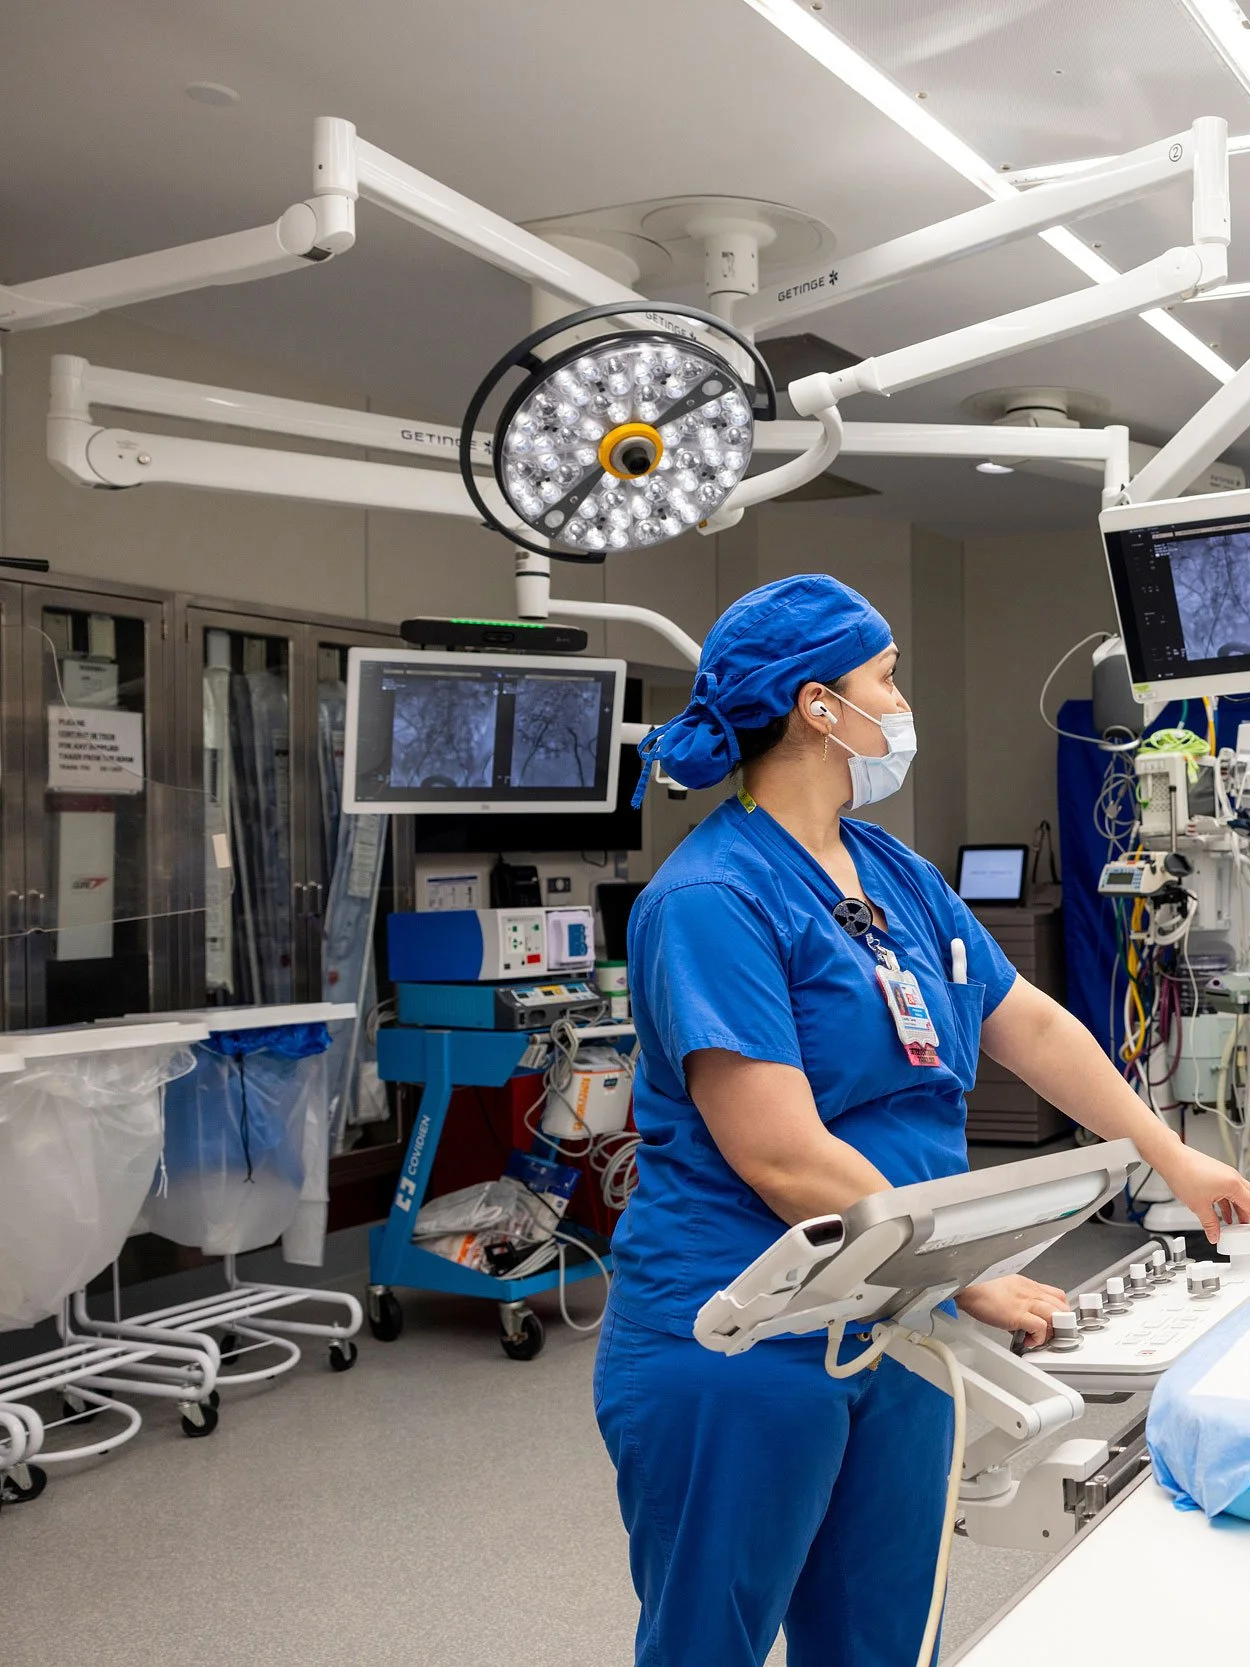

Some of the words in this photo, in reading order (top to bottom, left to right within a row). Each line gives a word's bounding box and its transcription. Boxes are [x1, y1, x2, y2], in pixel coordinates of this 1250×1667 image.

[778, 276, 825, 302] GETINGE
[400, 429, 478, 450] GETINE
[408, 1114, 430, 1175] COVIDEN
